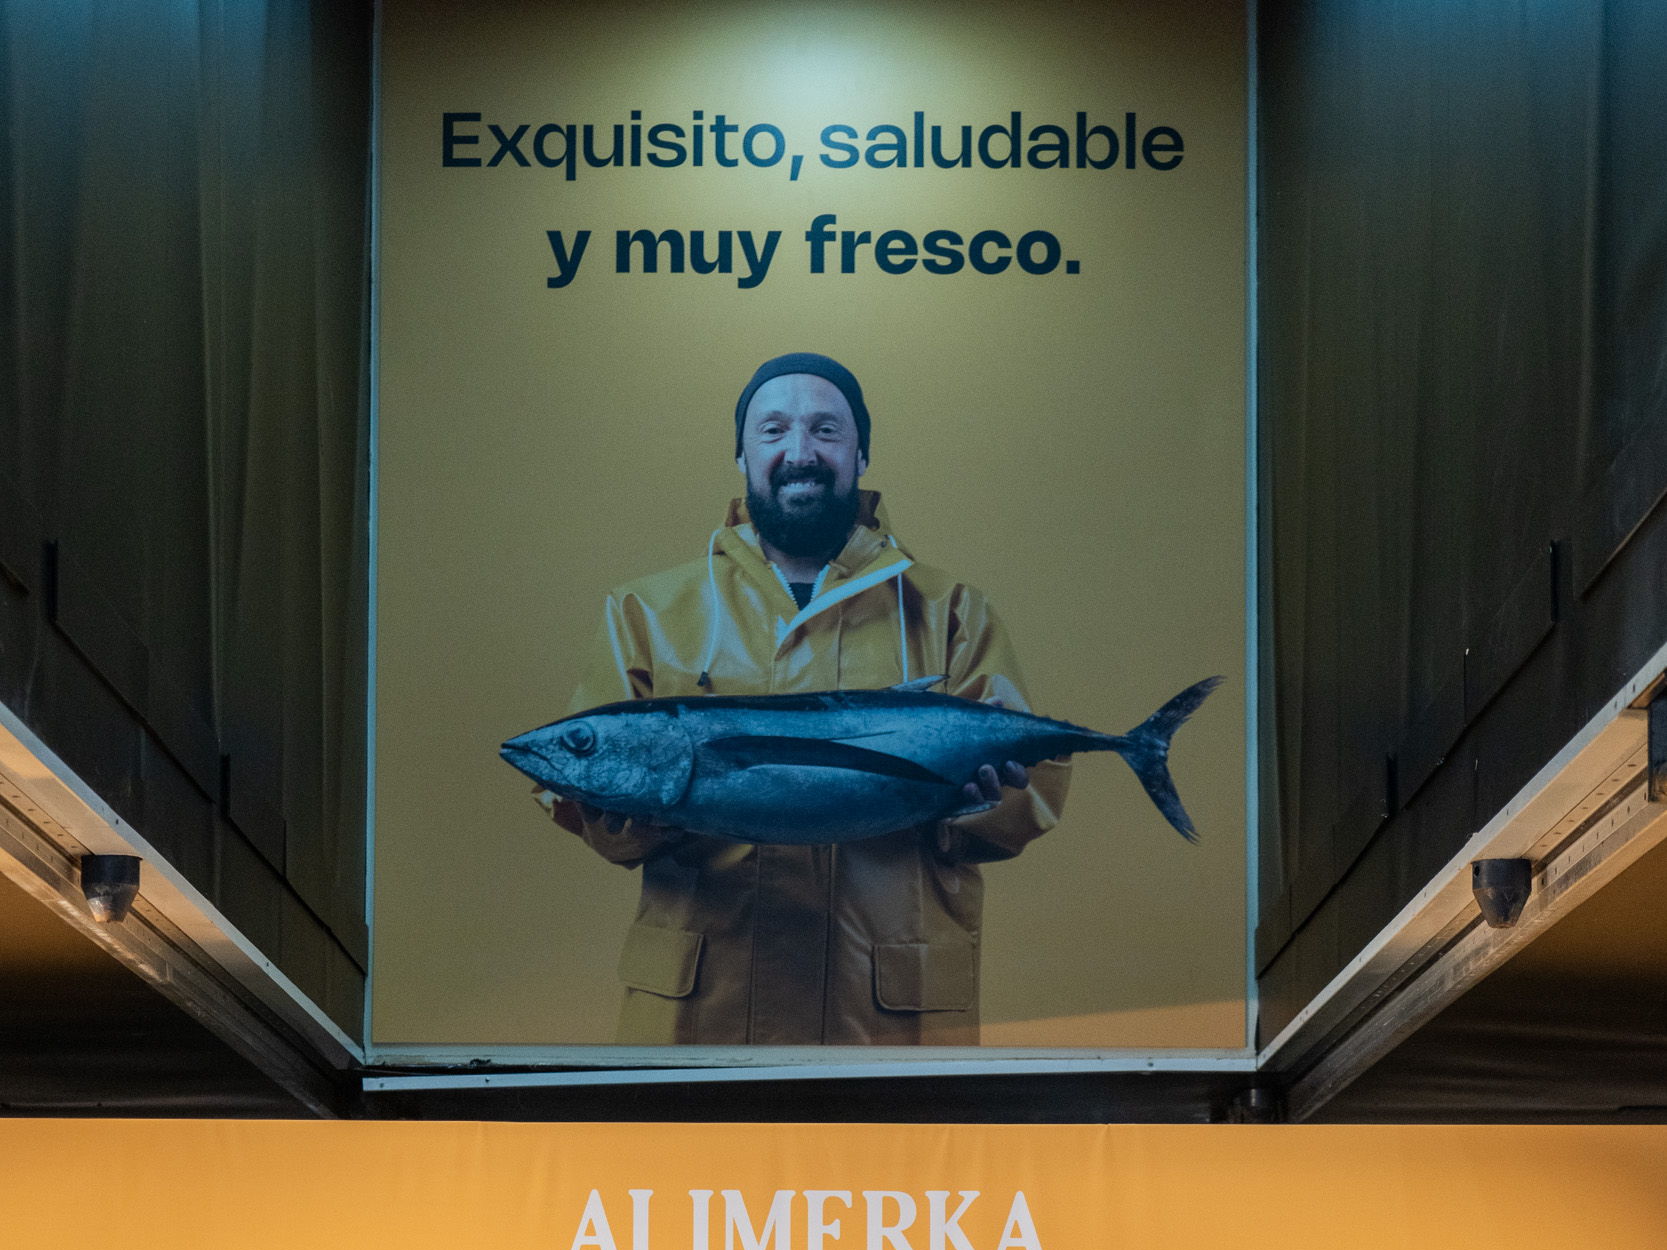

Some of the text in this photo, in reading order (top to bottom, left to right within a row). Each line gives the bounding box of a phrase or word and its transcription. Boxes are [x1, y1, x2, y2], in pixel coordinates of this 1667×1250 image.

[441, 110, 1186, 181] Exquisito, saludable
[546, 214, 1082, 289] y muy fresco.
